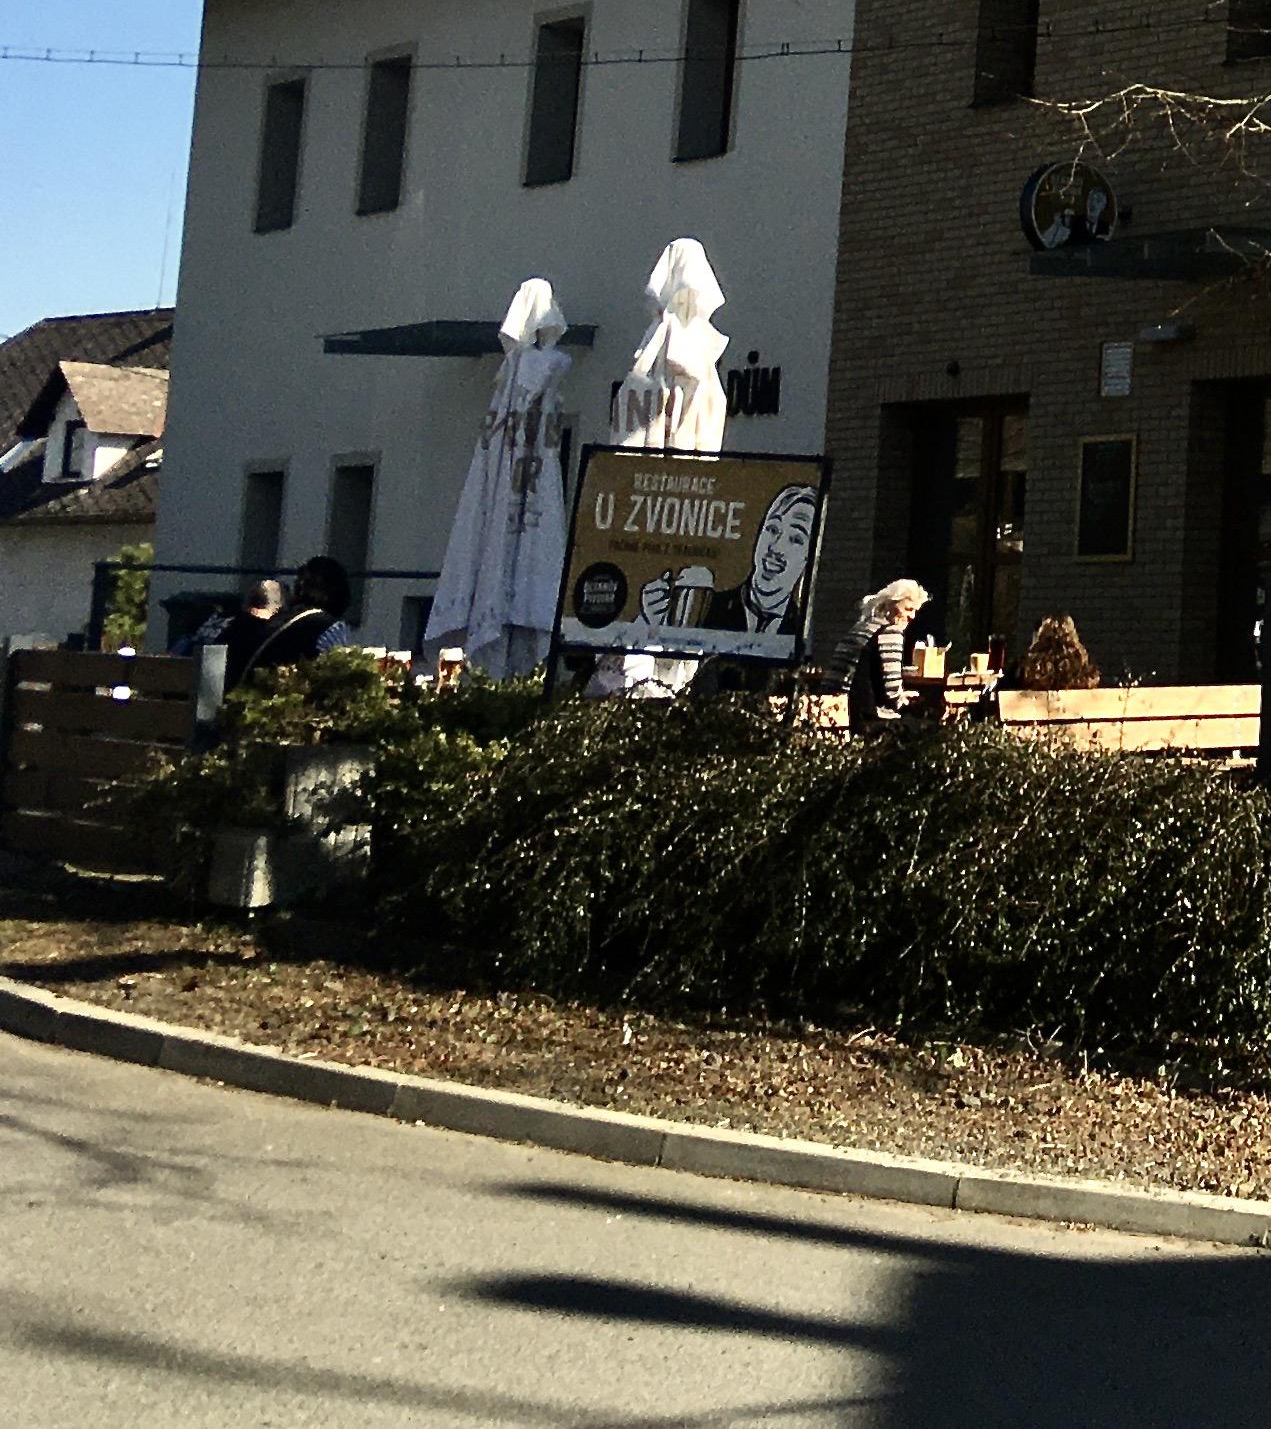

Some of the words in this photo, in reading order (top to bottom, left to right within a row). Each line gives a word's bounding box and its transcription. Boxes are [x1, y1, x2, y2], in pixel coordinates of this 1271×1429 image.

[634, 471, 718, 496] RESTAURACE
[595, 491, 616, 531] U
[623, 494, 744, 539] ZVONICE
